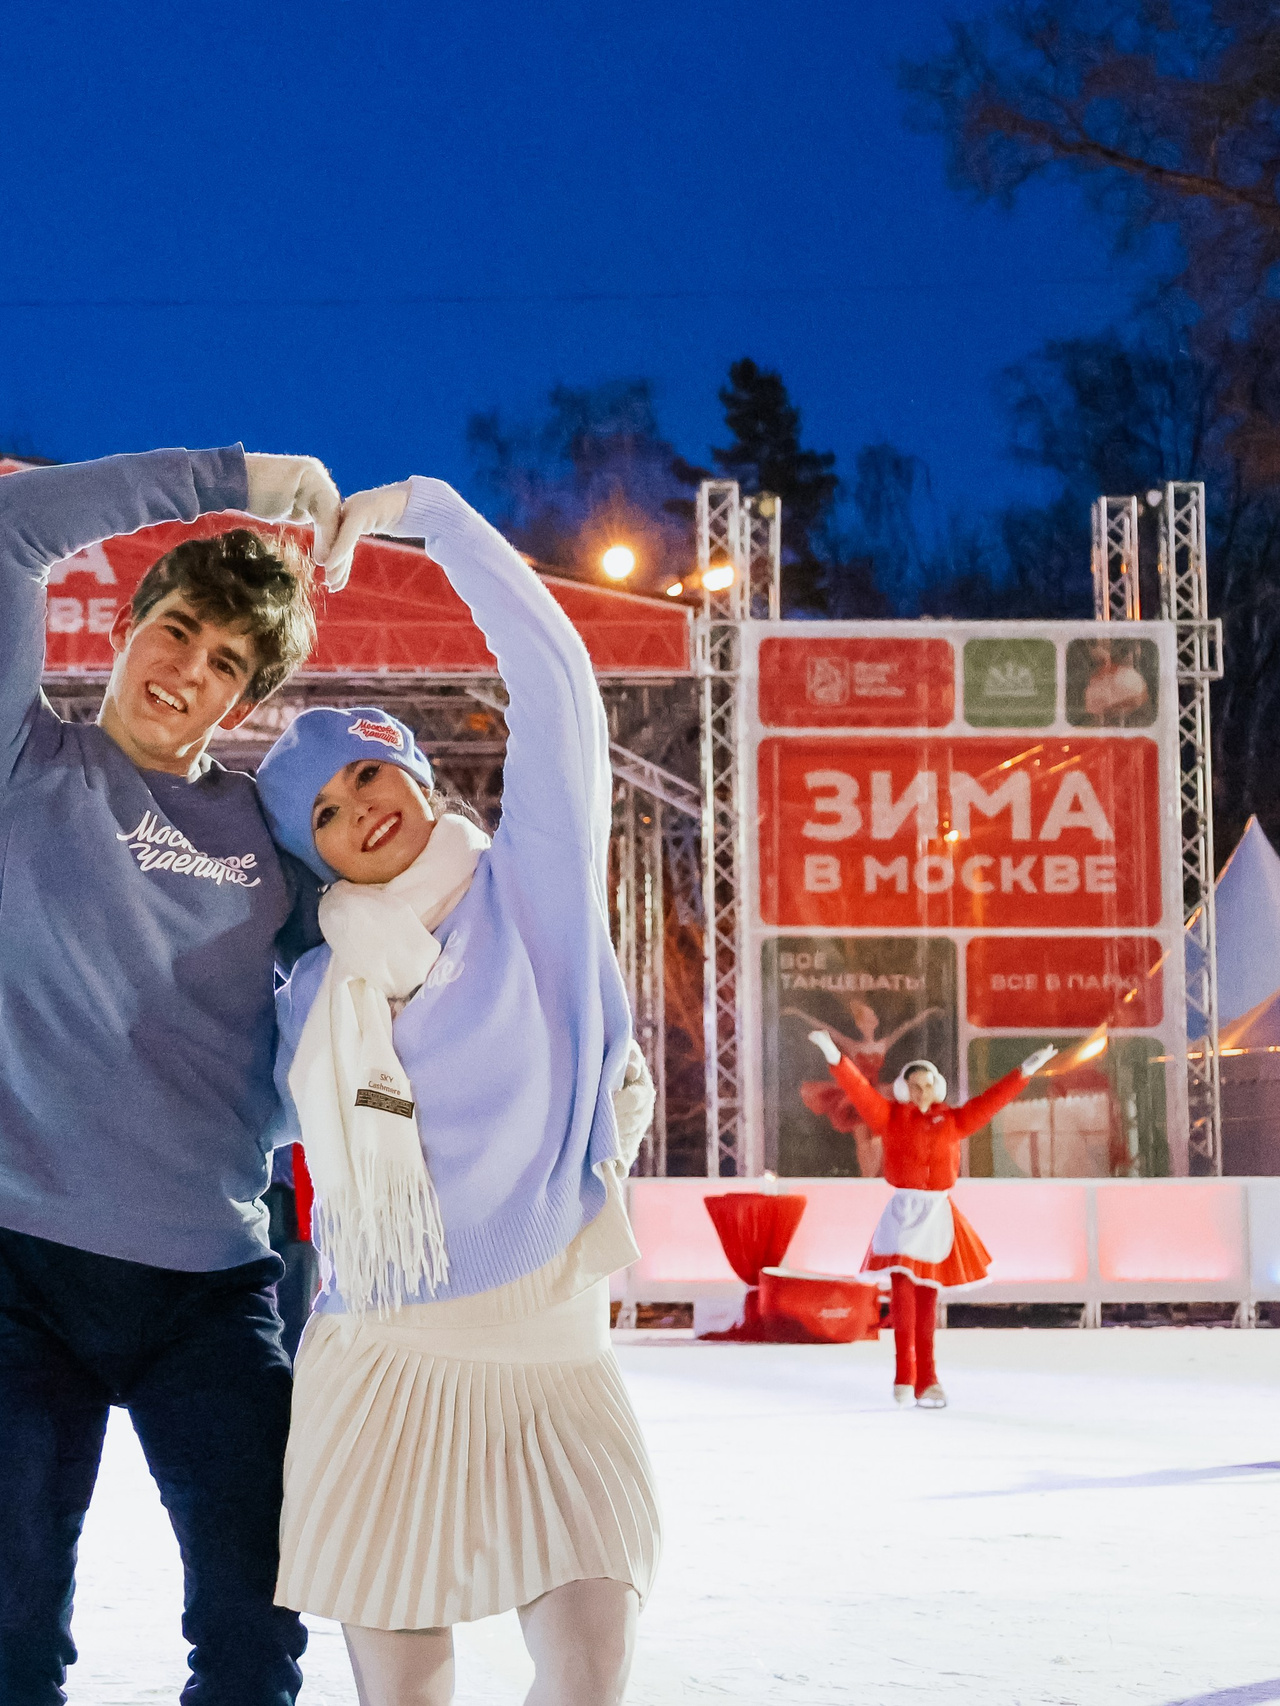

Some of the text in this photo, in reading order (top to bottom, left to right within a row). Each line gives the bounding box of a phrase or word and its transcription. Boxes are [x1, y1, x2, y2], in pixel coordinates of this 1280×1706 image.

[802, 769, 1116, 842] ЗИМА
[804, 854, 1117, 895] В МОСКВЕ
[1045, 973, 1061, 991] В
